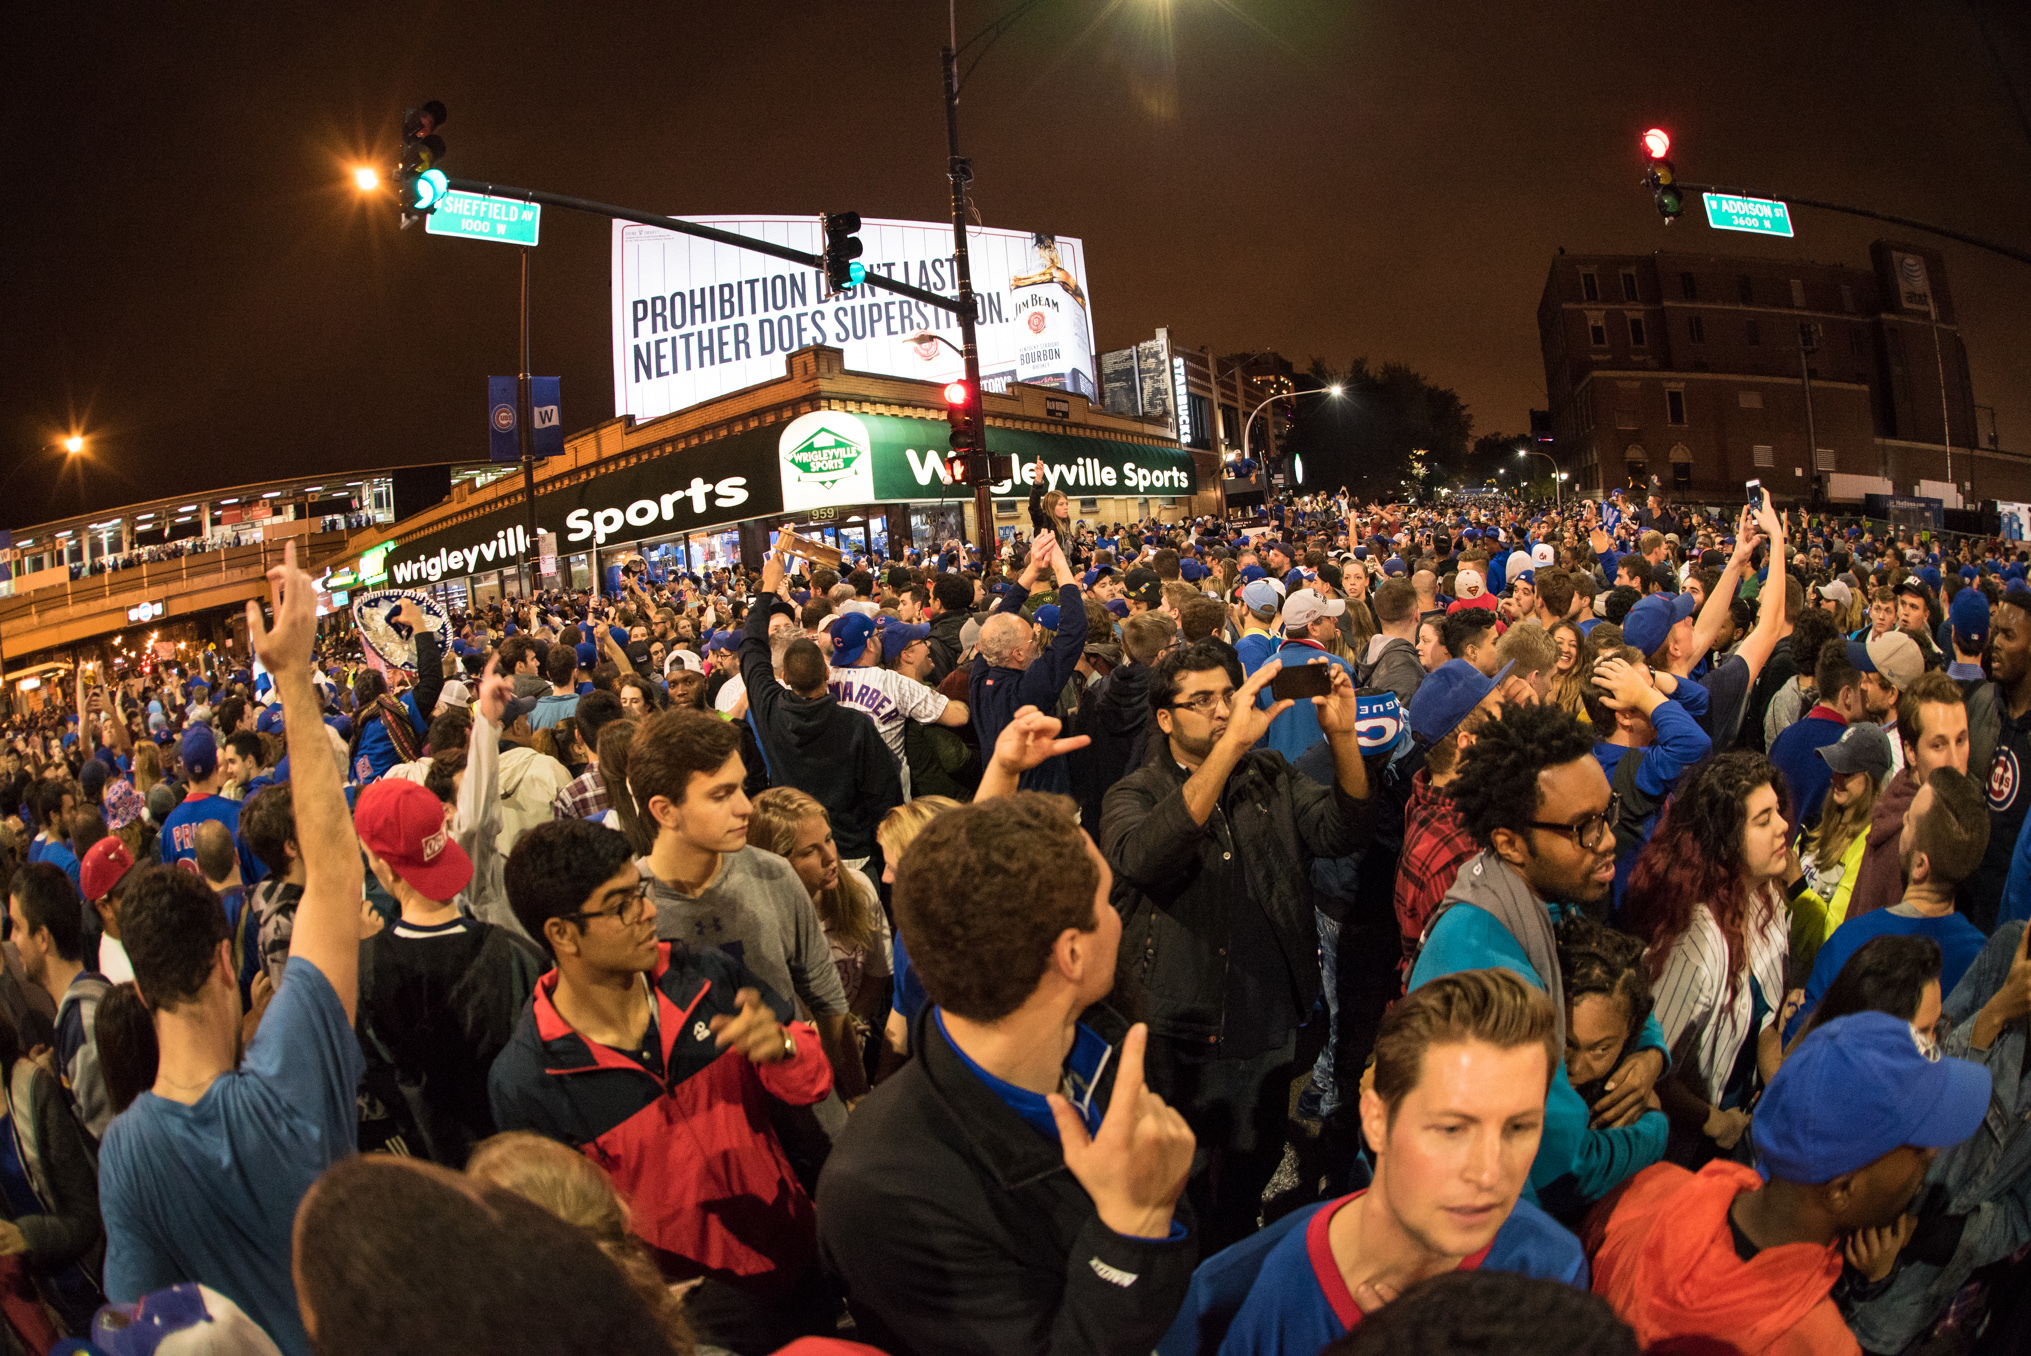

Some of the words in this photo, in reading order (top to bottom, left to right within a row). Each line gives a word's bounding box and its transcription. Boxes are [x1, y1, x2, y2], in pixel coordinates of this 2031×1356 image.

[444, 196, 518, 222] SHEFFIELD
[521, 210, 533, 222] AV
[1709, 200, 1718, 209] W
[1722, 199, 1773, 218] ADDISON
[1774, 208, 1784, 218] ST
[461, 218, 490, 233] 1000
[496, 223, 507, 235] W
[1732, 215, 1759, 227] 3600
[1763, 219, 1772, 229] N
[632, 271, 807, 339] PROHIBITION
[1014, 299, 1029, 321] JIM
[1031, 293, 1060, 313] BEAM
[633, 322, 751, 383] NEITHER
[759, 309, 827, 356] DOES
[1020, 347, 1061, 366] BOURBON
[1173, 357, 1192, 444] STARBUCKS
[539, 408, 553, 425] W
[793, 446, 858, 464] WRIGLEYVILLE
[810, 459, 844, 472] SPORTS
[1123, 461, 1188, 492] Sports
[566, 476, 749, 543] Sports
[812, 507, 835, 520] 959
[834, 637, 844, 647] C
